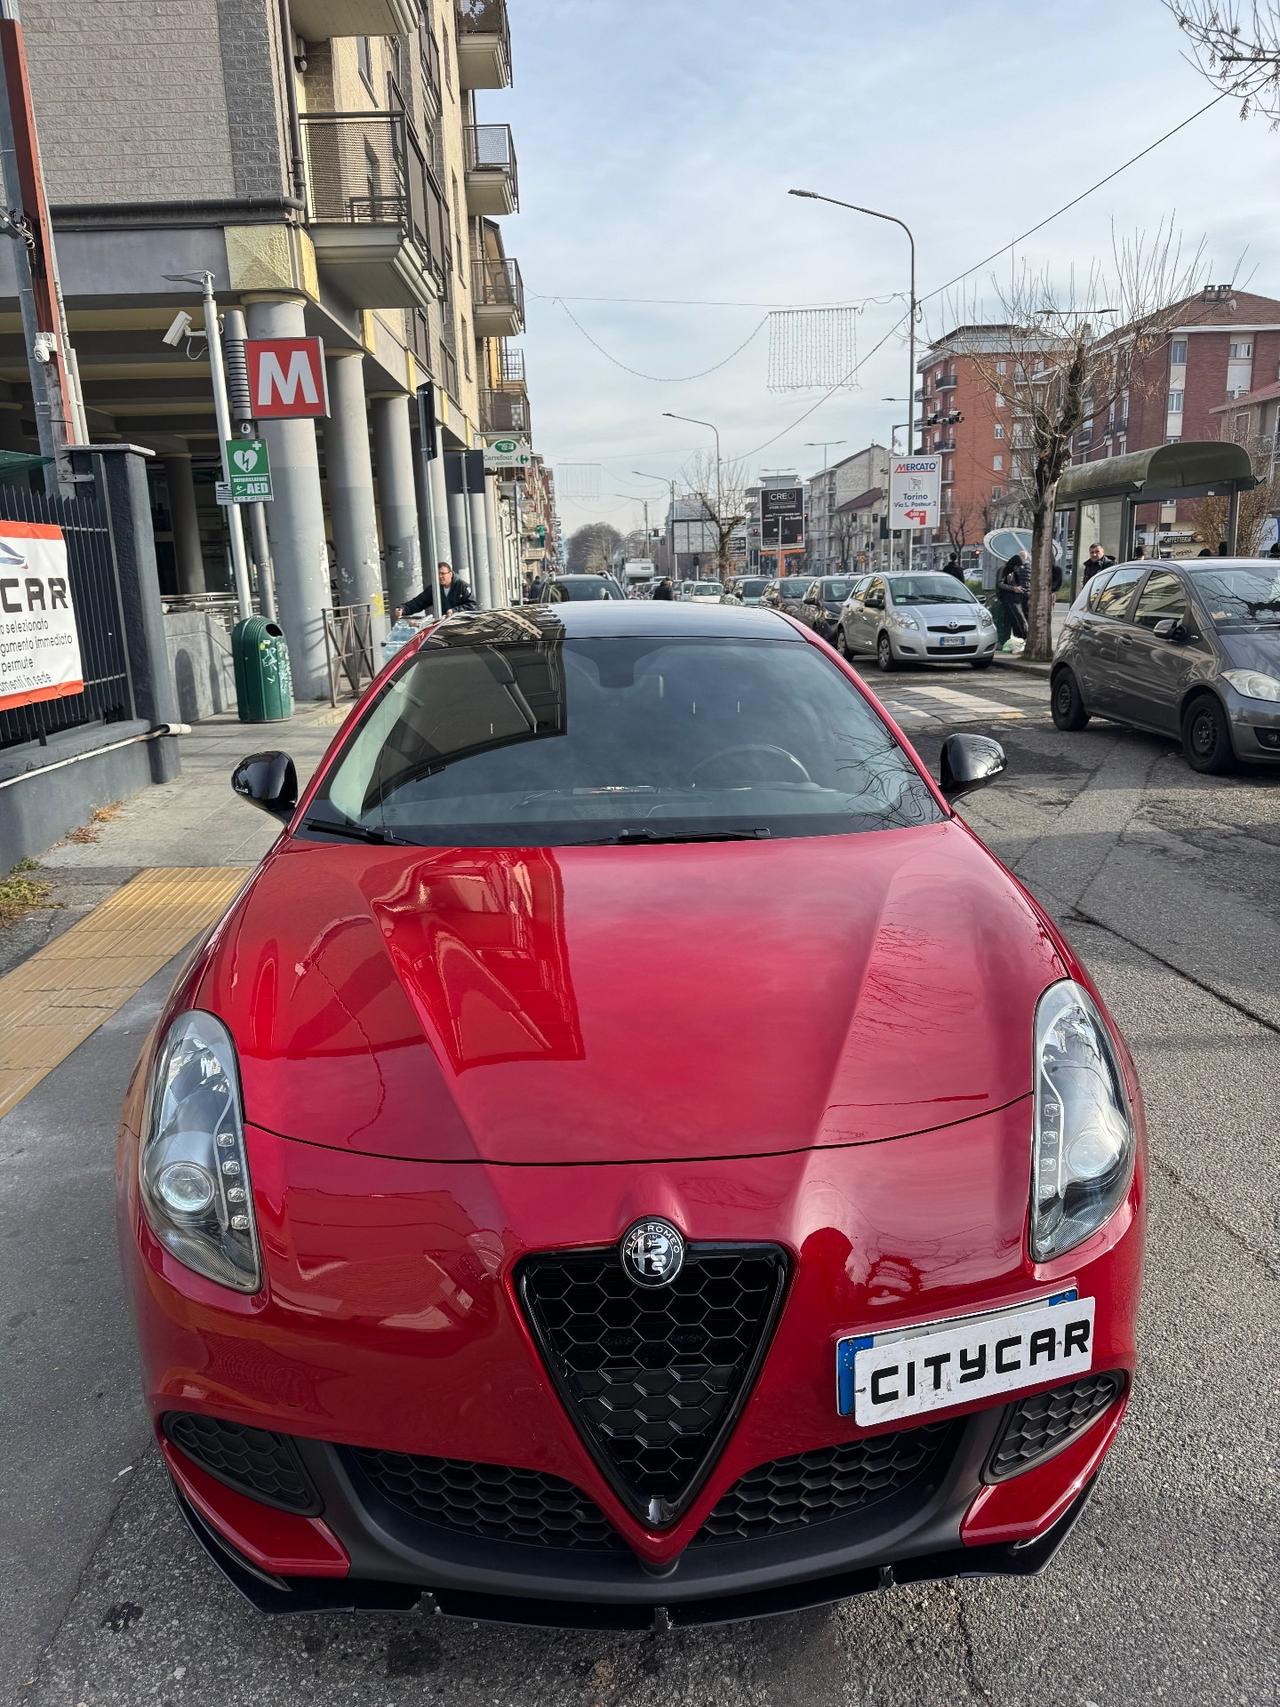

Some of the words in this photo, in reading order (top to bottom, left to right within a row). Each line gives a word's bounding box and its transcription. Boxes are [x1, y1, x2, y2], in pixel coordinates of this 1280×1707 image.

[258, 351, 319, 405] M
[895, 462, 936, 473] MERCATO
[247, 483, 269, 494] AED
[770, 492, 794, 500] CREO
[903, 492, 928, 500] Torino
[0, 578, 69, 613] CAR
[6, 618, 49, 634] selezionato
[35, 633, 73, 648] immediato
[1, 658, 33, 675] permute
[24, 674, 35, 687] in
[33, 672, 52, 684] sede
[625, 1229, 645, 1256] ALFA
[647, 1225, 680, 1254] ROMEO
[871, 1318, 1091, 1405] CITYCAR
